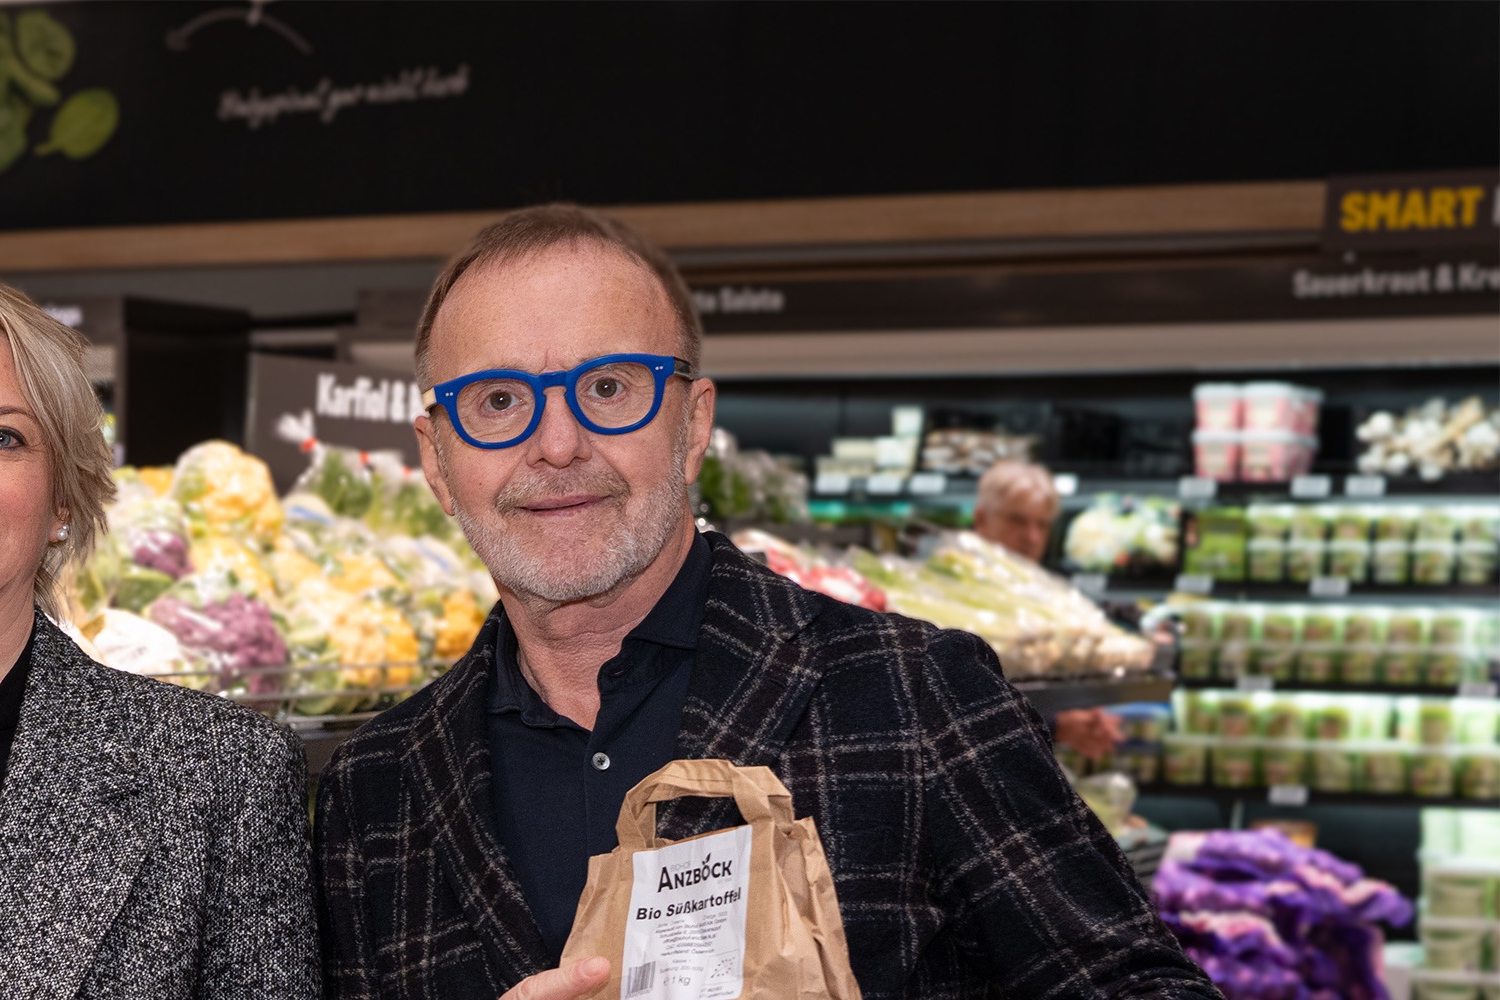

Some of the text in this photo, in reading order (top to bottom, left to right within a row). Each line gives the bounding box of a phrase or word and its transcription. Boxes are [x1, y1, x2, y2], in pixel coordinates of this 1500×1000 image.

[1341, 186, 1485, 232] SMART
[1293, 267, 1431, 299] Sauerkraut
[1435, 263, 1454, 293] &
[316, 372, 388, 422] Karfiol
[636, 887, 742, 920] Bio Süßkartoffel
